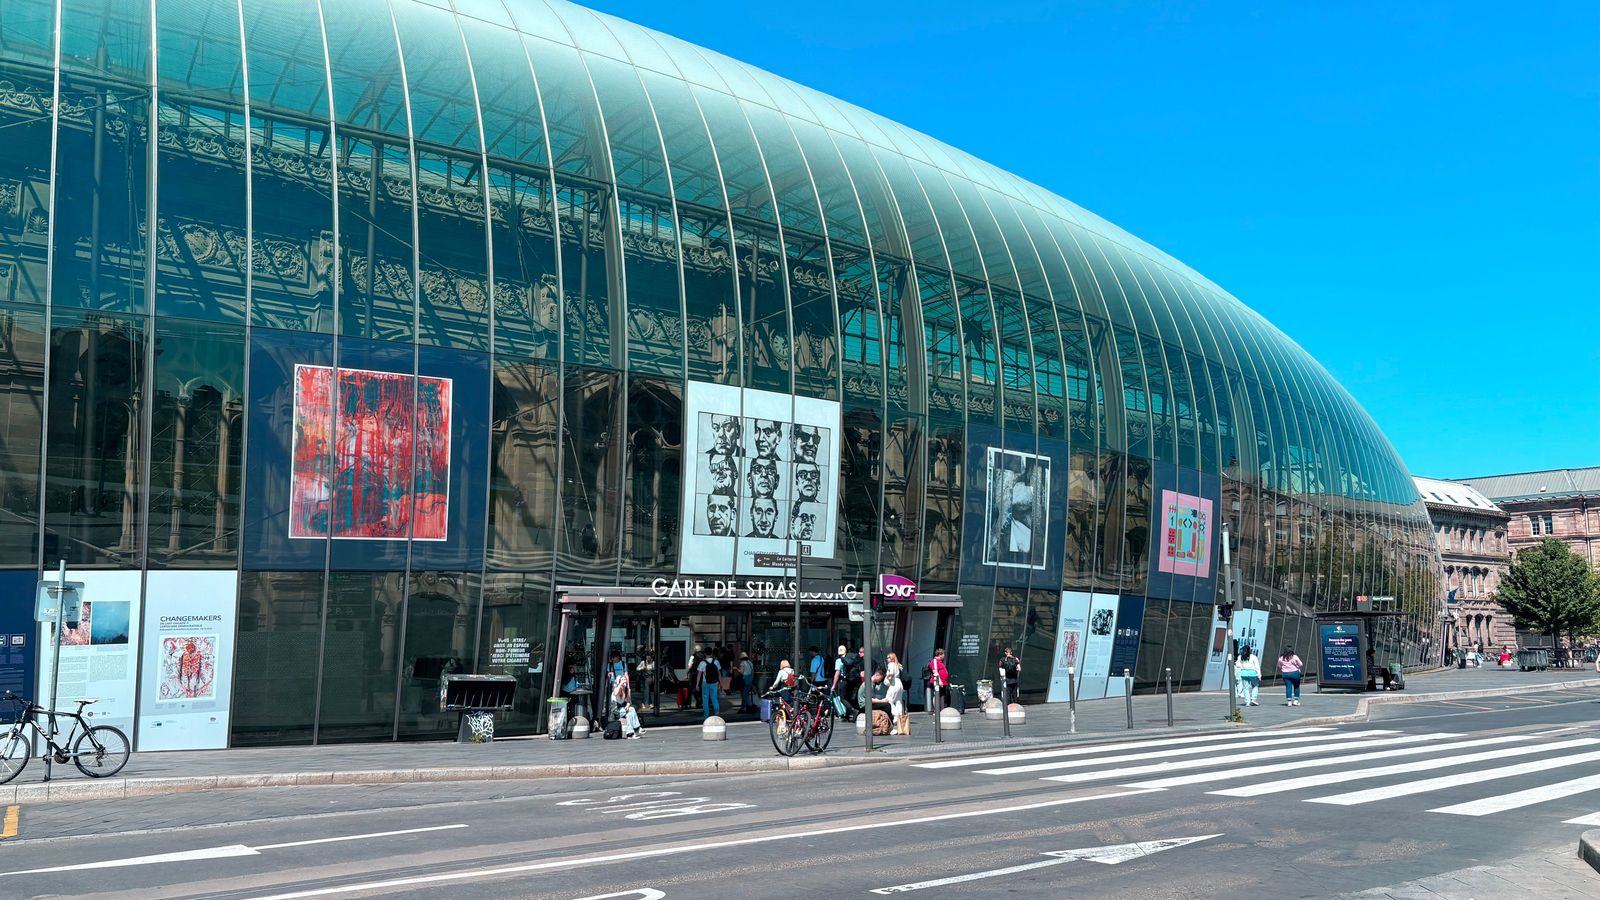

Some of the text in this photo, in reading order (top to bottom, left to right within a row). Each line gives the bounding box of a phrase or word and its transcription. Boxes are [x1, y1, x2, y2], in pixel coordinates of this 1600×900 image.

[651, 578, 705, 597] GARE
[714, 580, 737, 598] DE
[884, 584, 916, 597] SNCF
[555, 791, 759, 821] BUS
